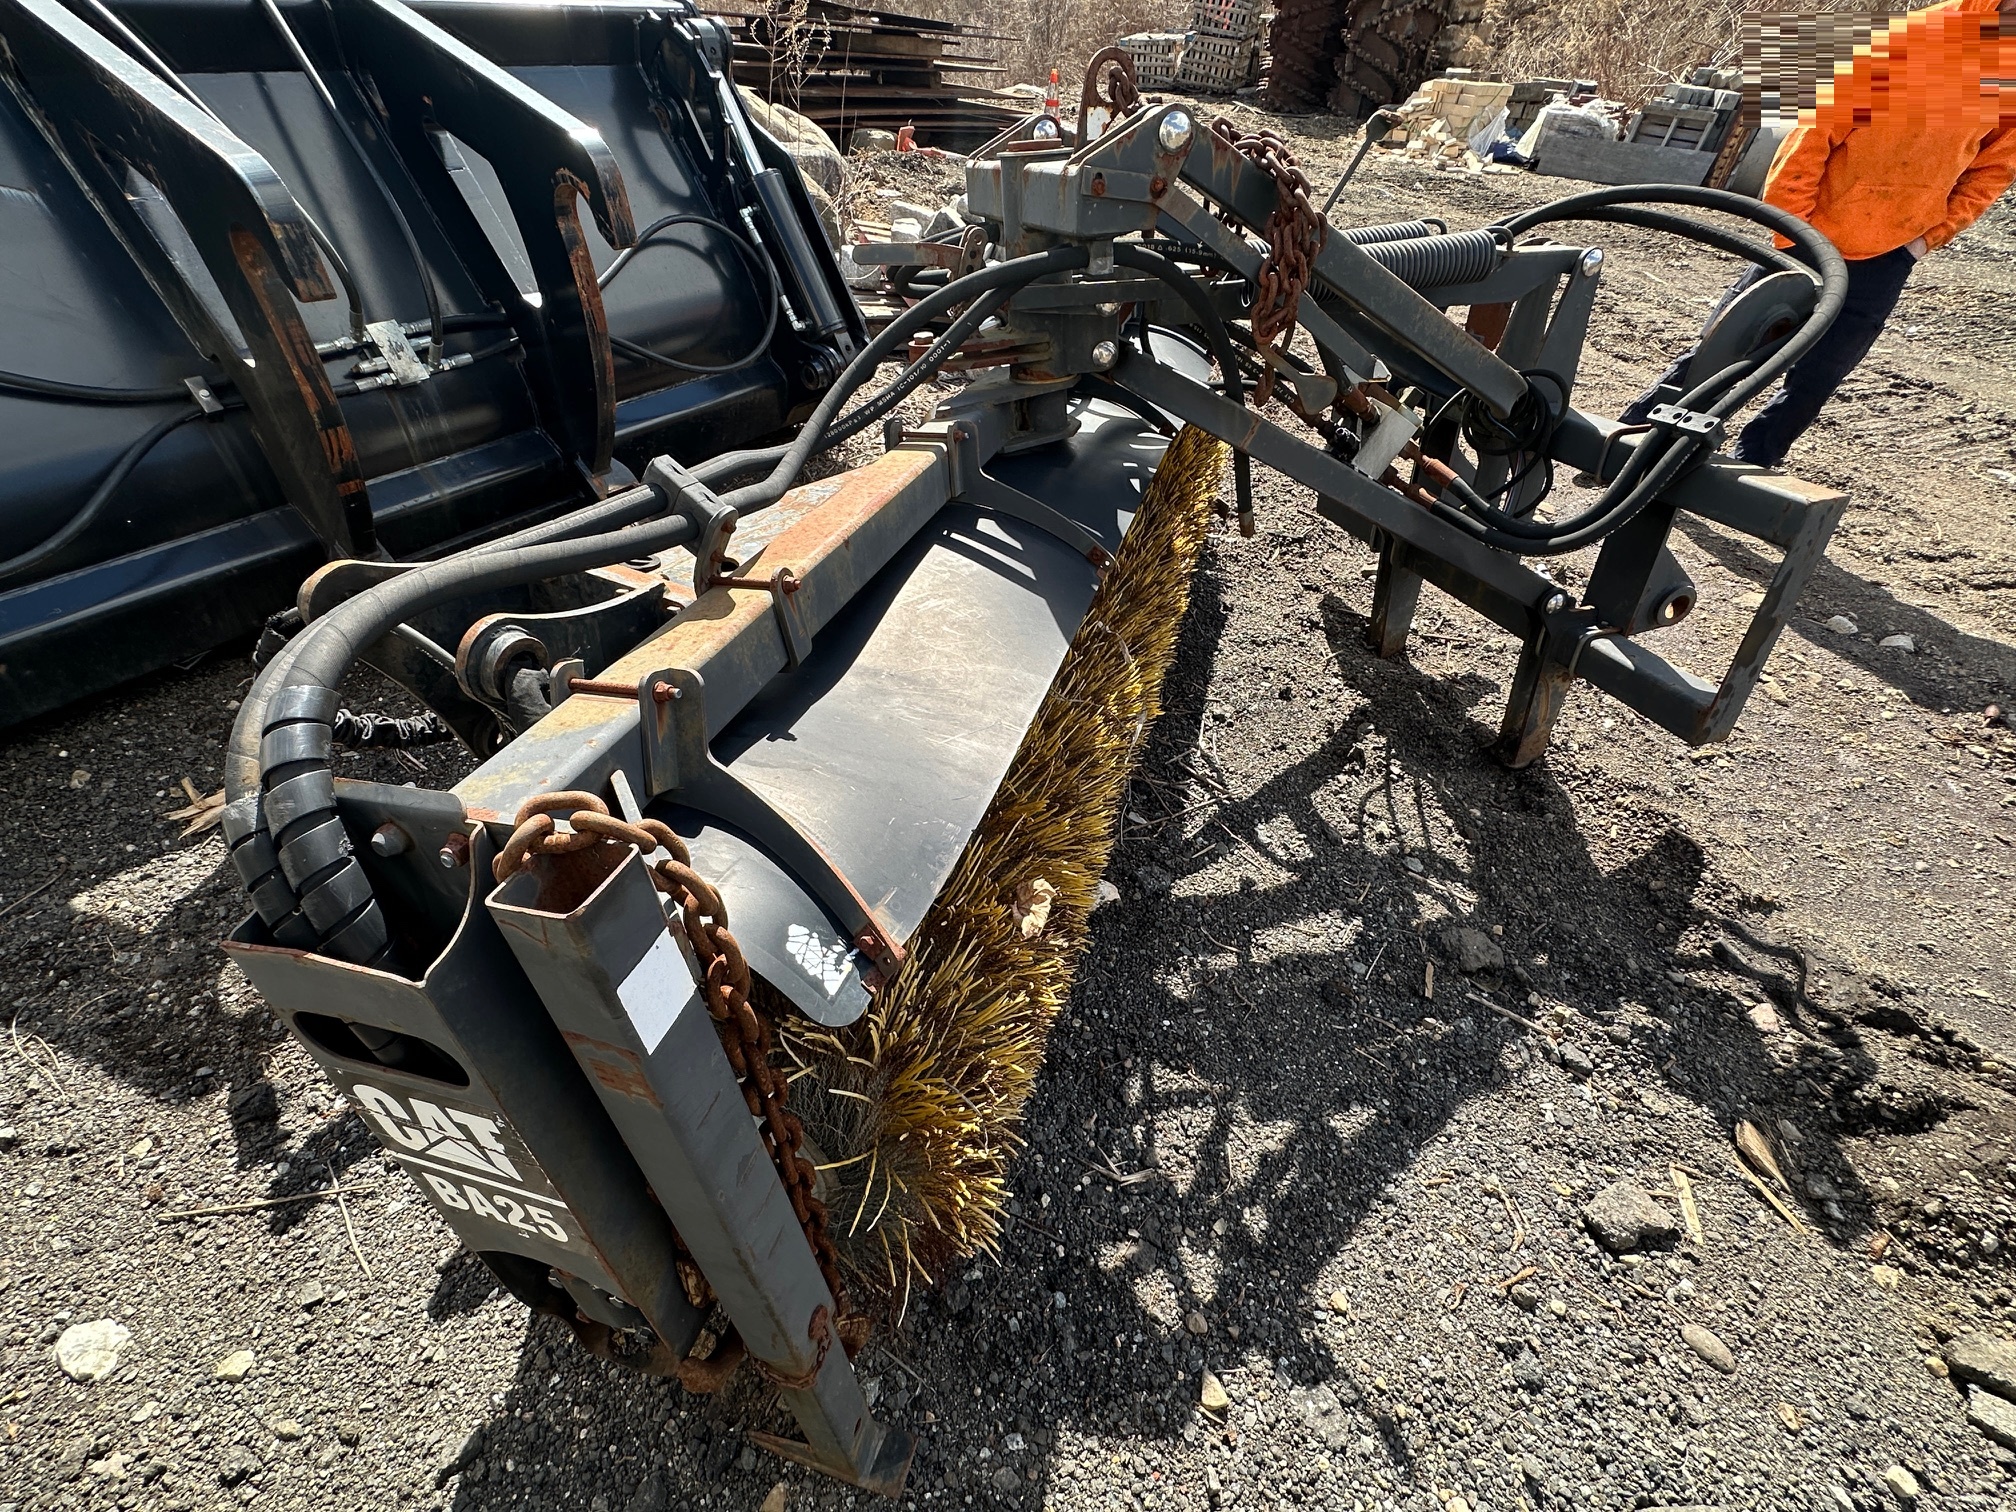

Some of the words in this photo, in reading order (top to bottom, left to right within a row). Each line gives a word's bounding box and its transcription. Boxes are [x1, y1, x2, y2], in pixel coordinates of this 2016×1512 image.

[864, 405, 875, 416] WP
[353, 1084, 523, 1182] CAT
[422, 1172, 569, 1243] BA25
